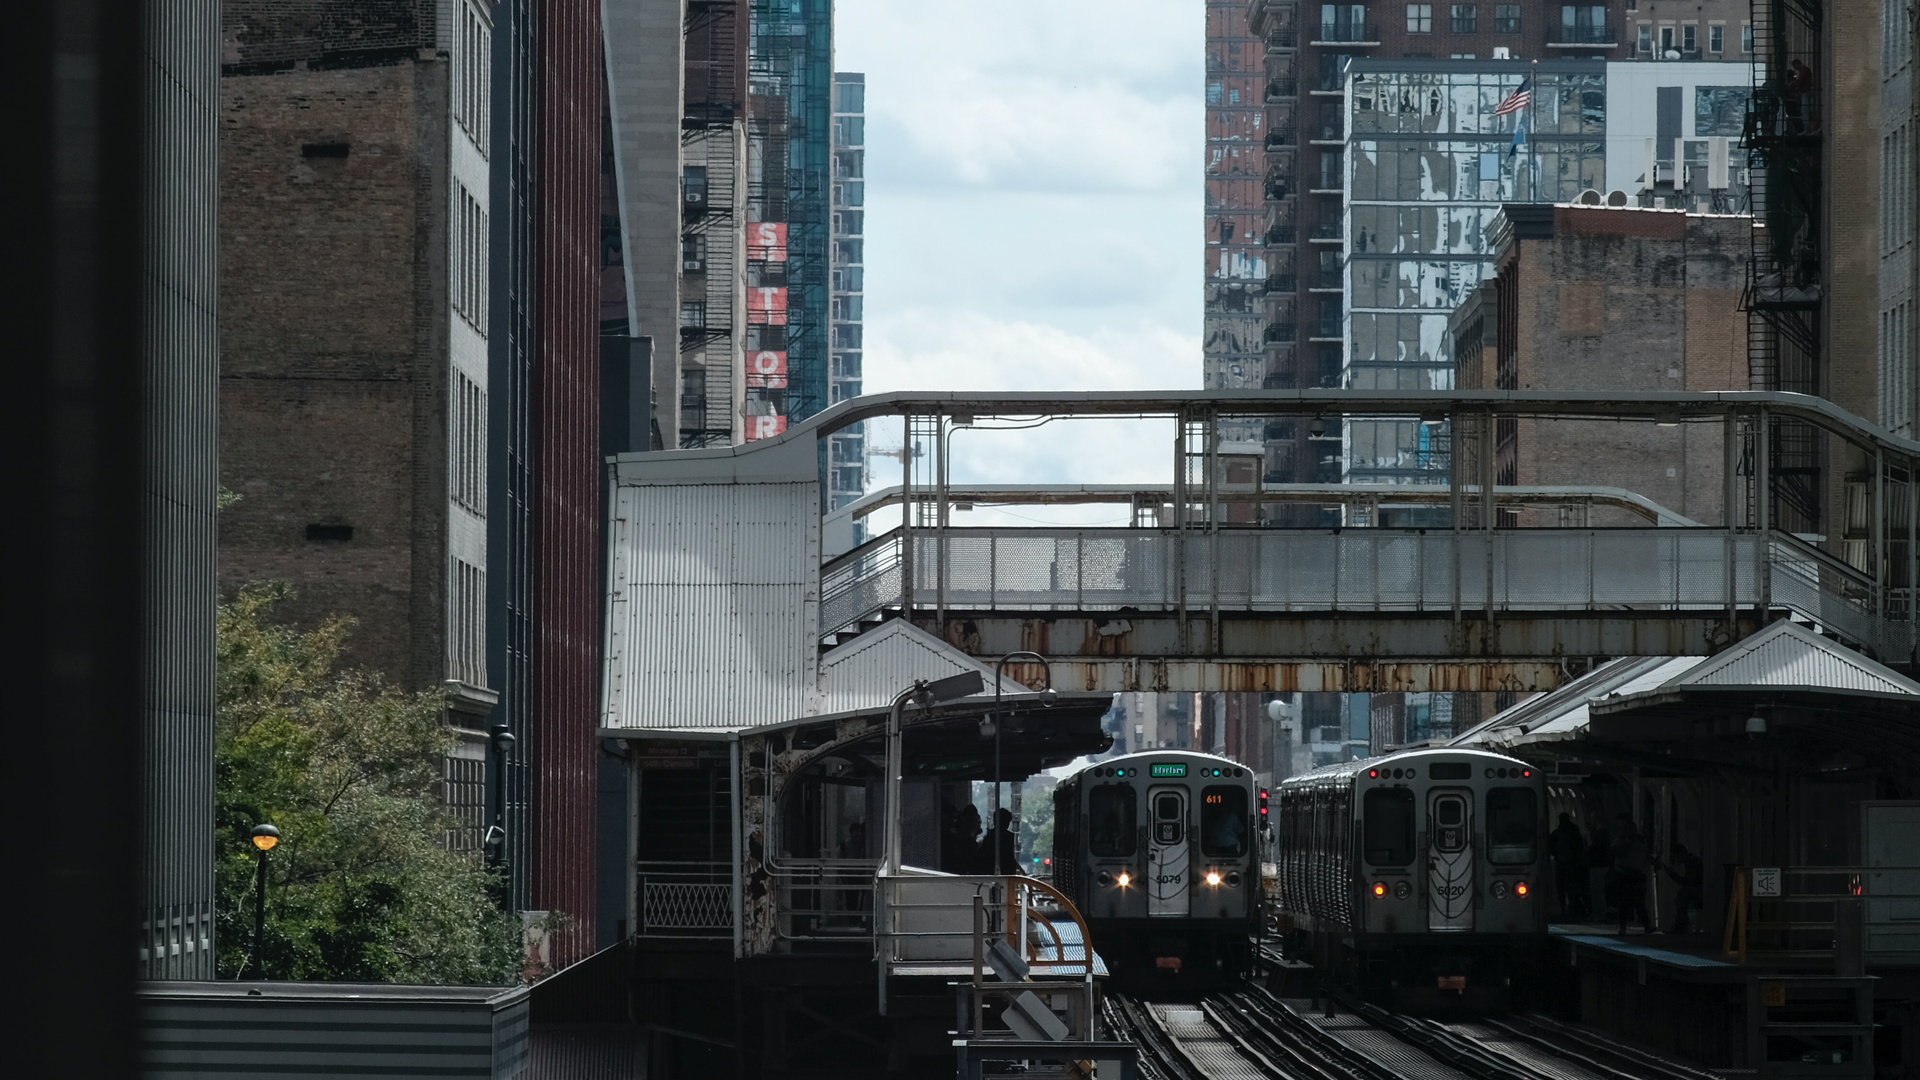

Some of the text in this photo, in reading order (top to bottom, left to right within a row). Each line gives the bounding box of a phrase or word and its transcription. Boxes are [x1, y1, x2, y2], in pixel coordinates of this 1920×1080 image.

[648, 747, 679, 756] Midway
[1206, 794, 1222, 804] 611
[1156, 875, 1181, 885] 5079
[1437, 885, 1465, 896] 5020
